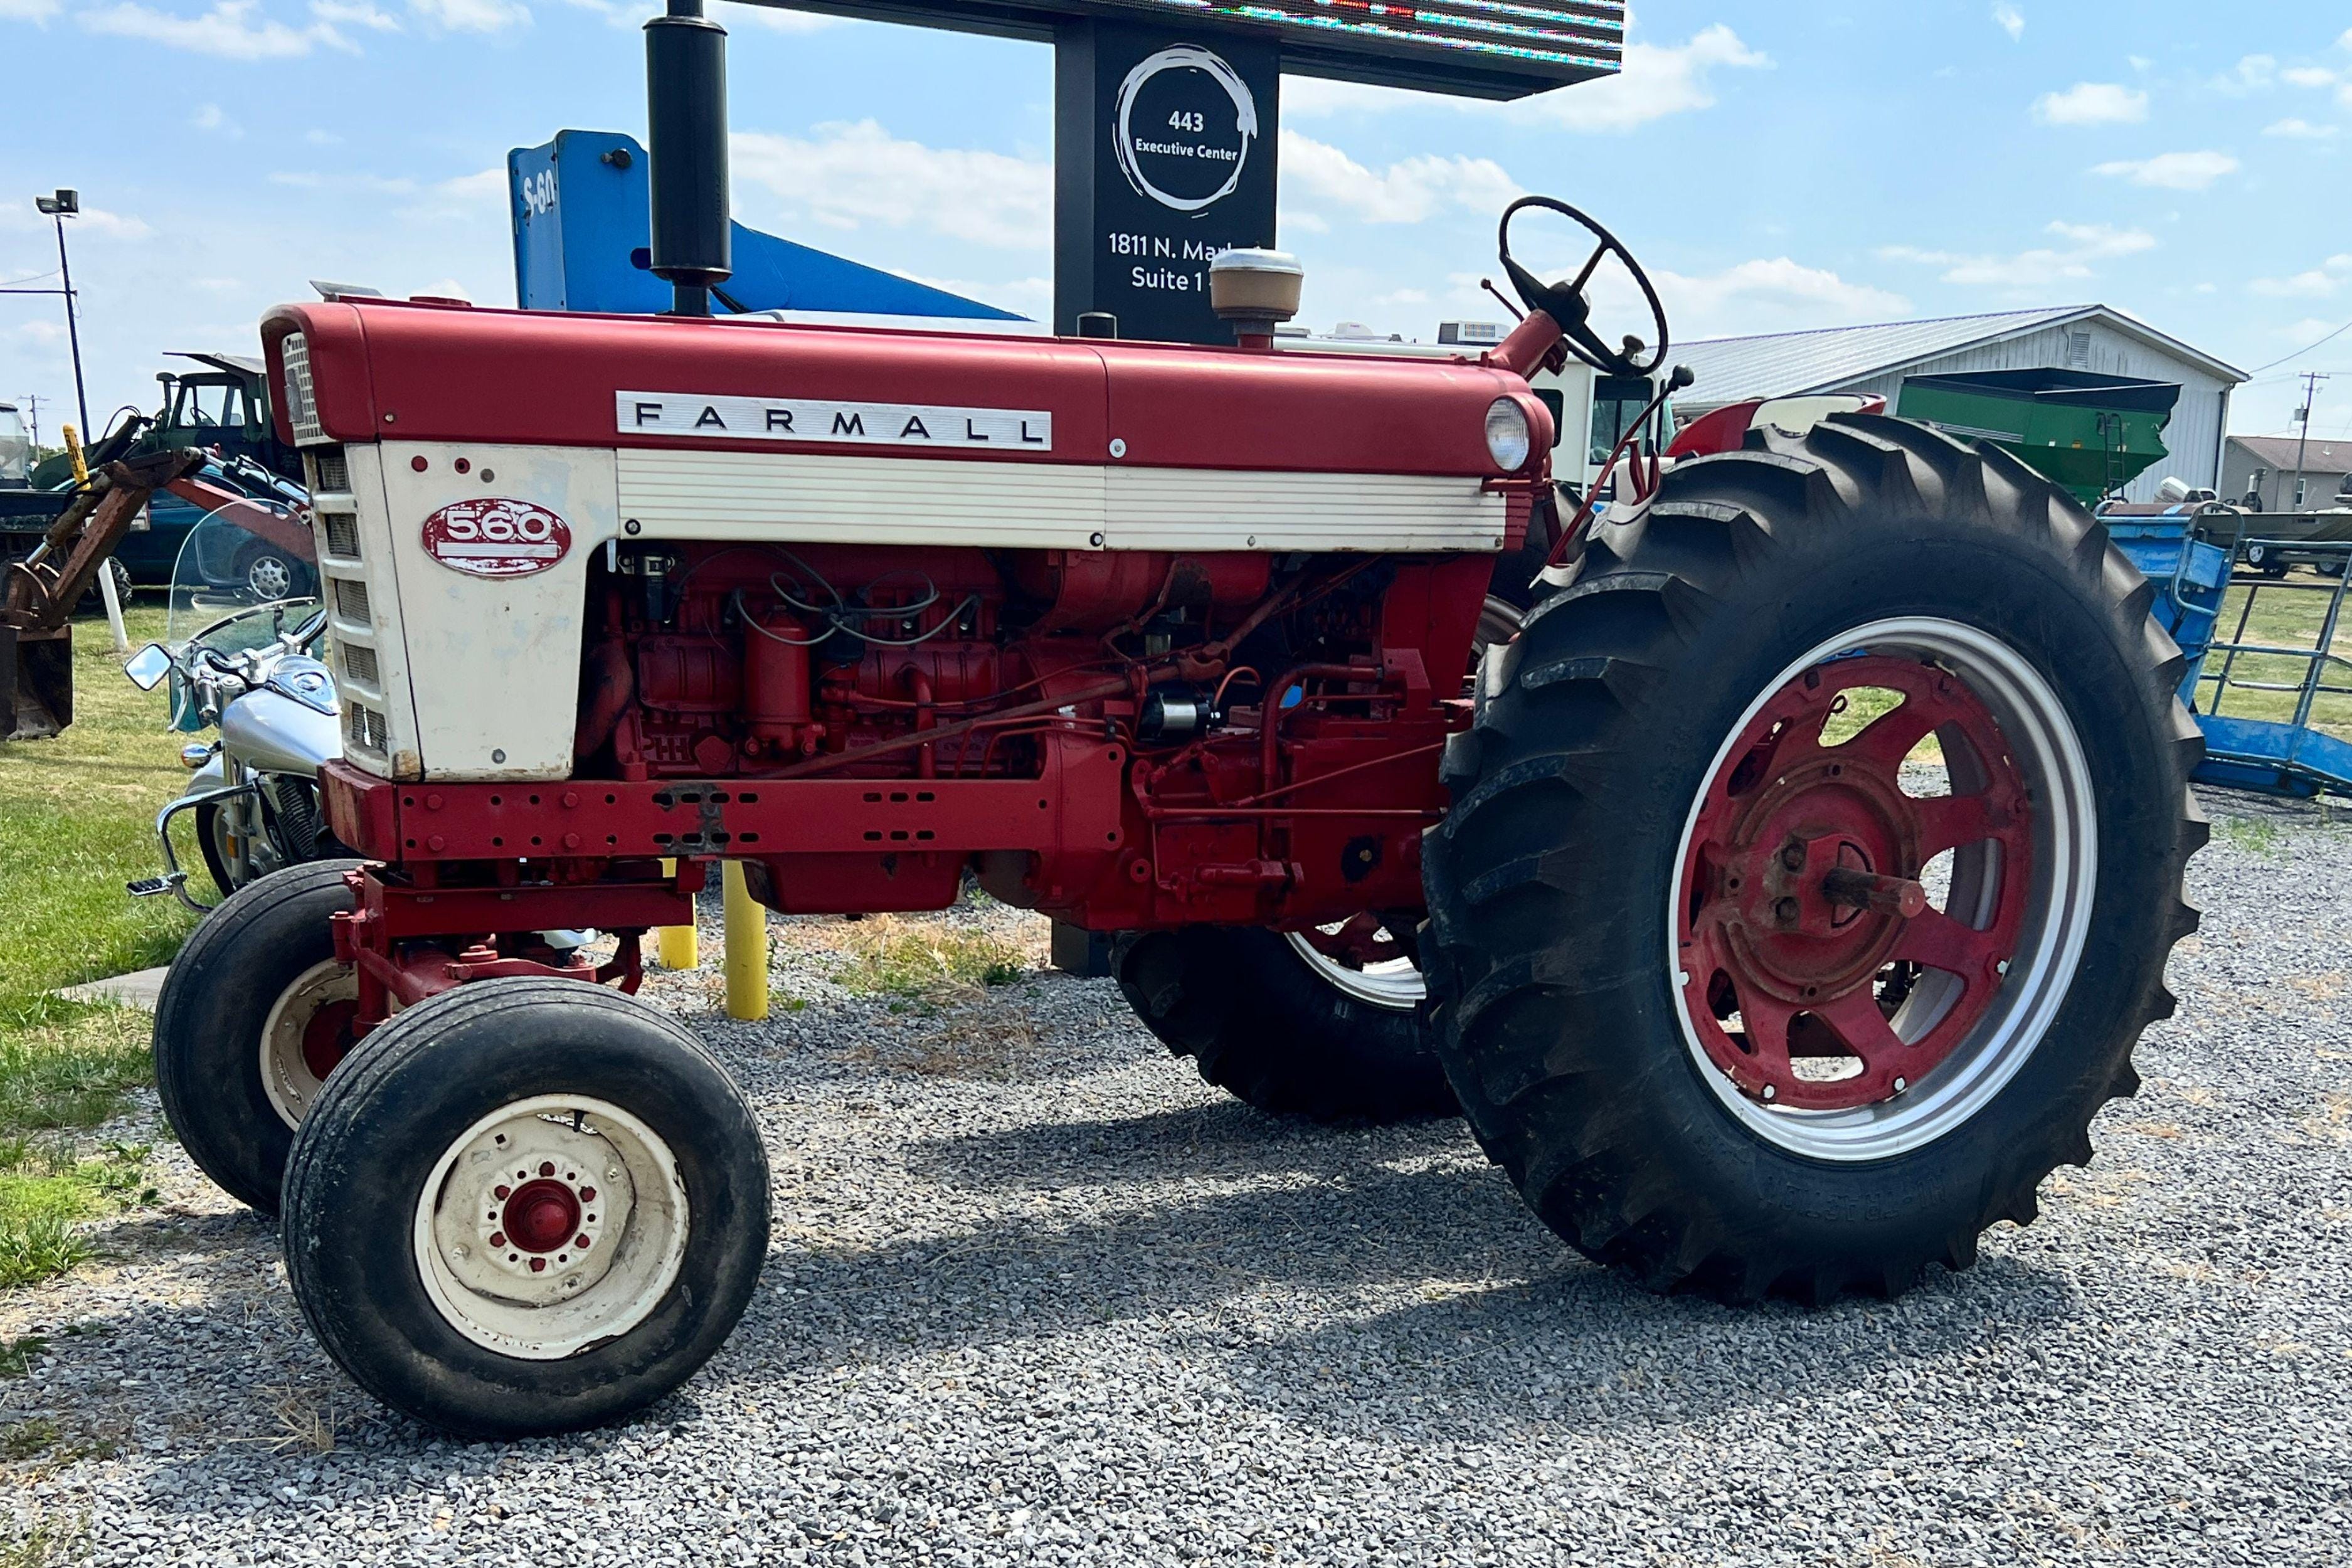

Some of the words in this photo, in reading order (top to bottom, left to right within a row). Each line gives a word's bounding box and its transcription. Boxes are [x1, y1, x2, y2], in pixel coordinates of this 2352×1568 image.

[1168, 110, 1204, 132] 443
[1135, 137, 1194, 157] Executive
[1196, 144, 1238, 161] Center
[1108, 232, 1147, 256] 1811
[1154, 237, 1177, 260] N.
[1131, 266, 1189, 291] Suite
[635, 402, 1044, 443] FARMALL
[446, 510, 553, 542] 560
